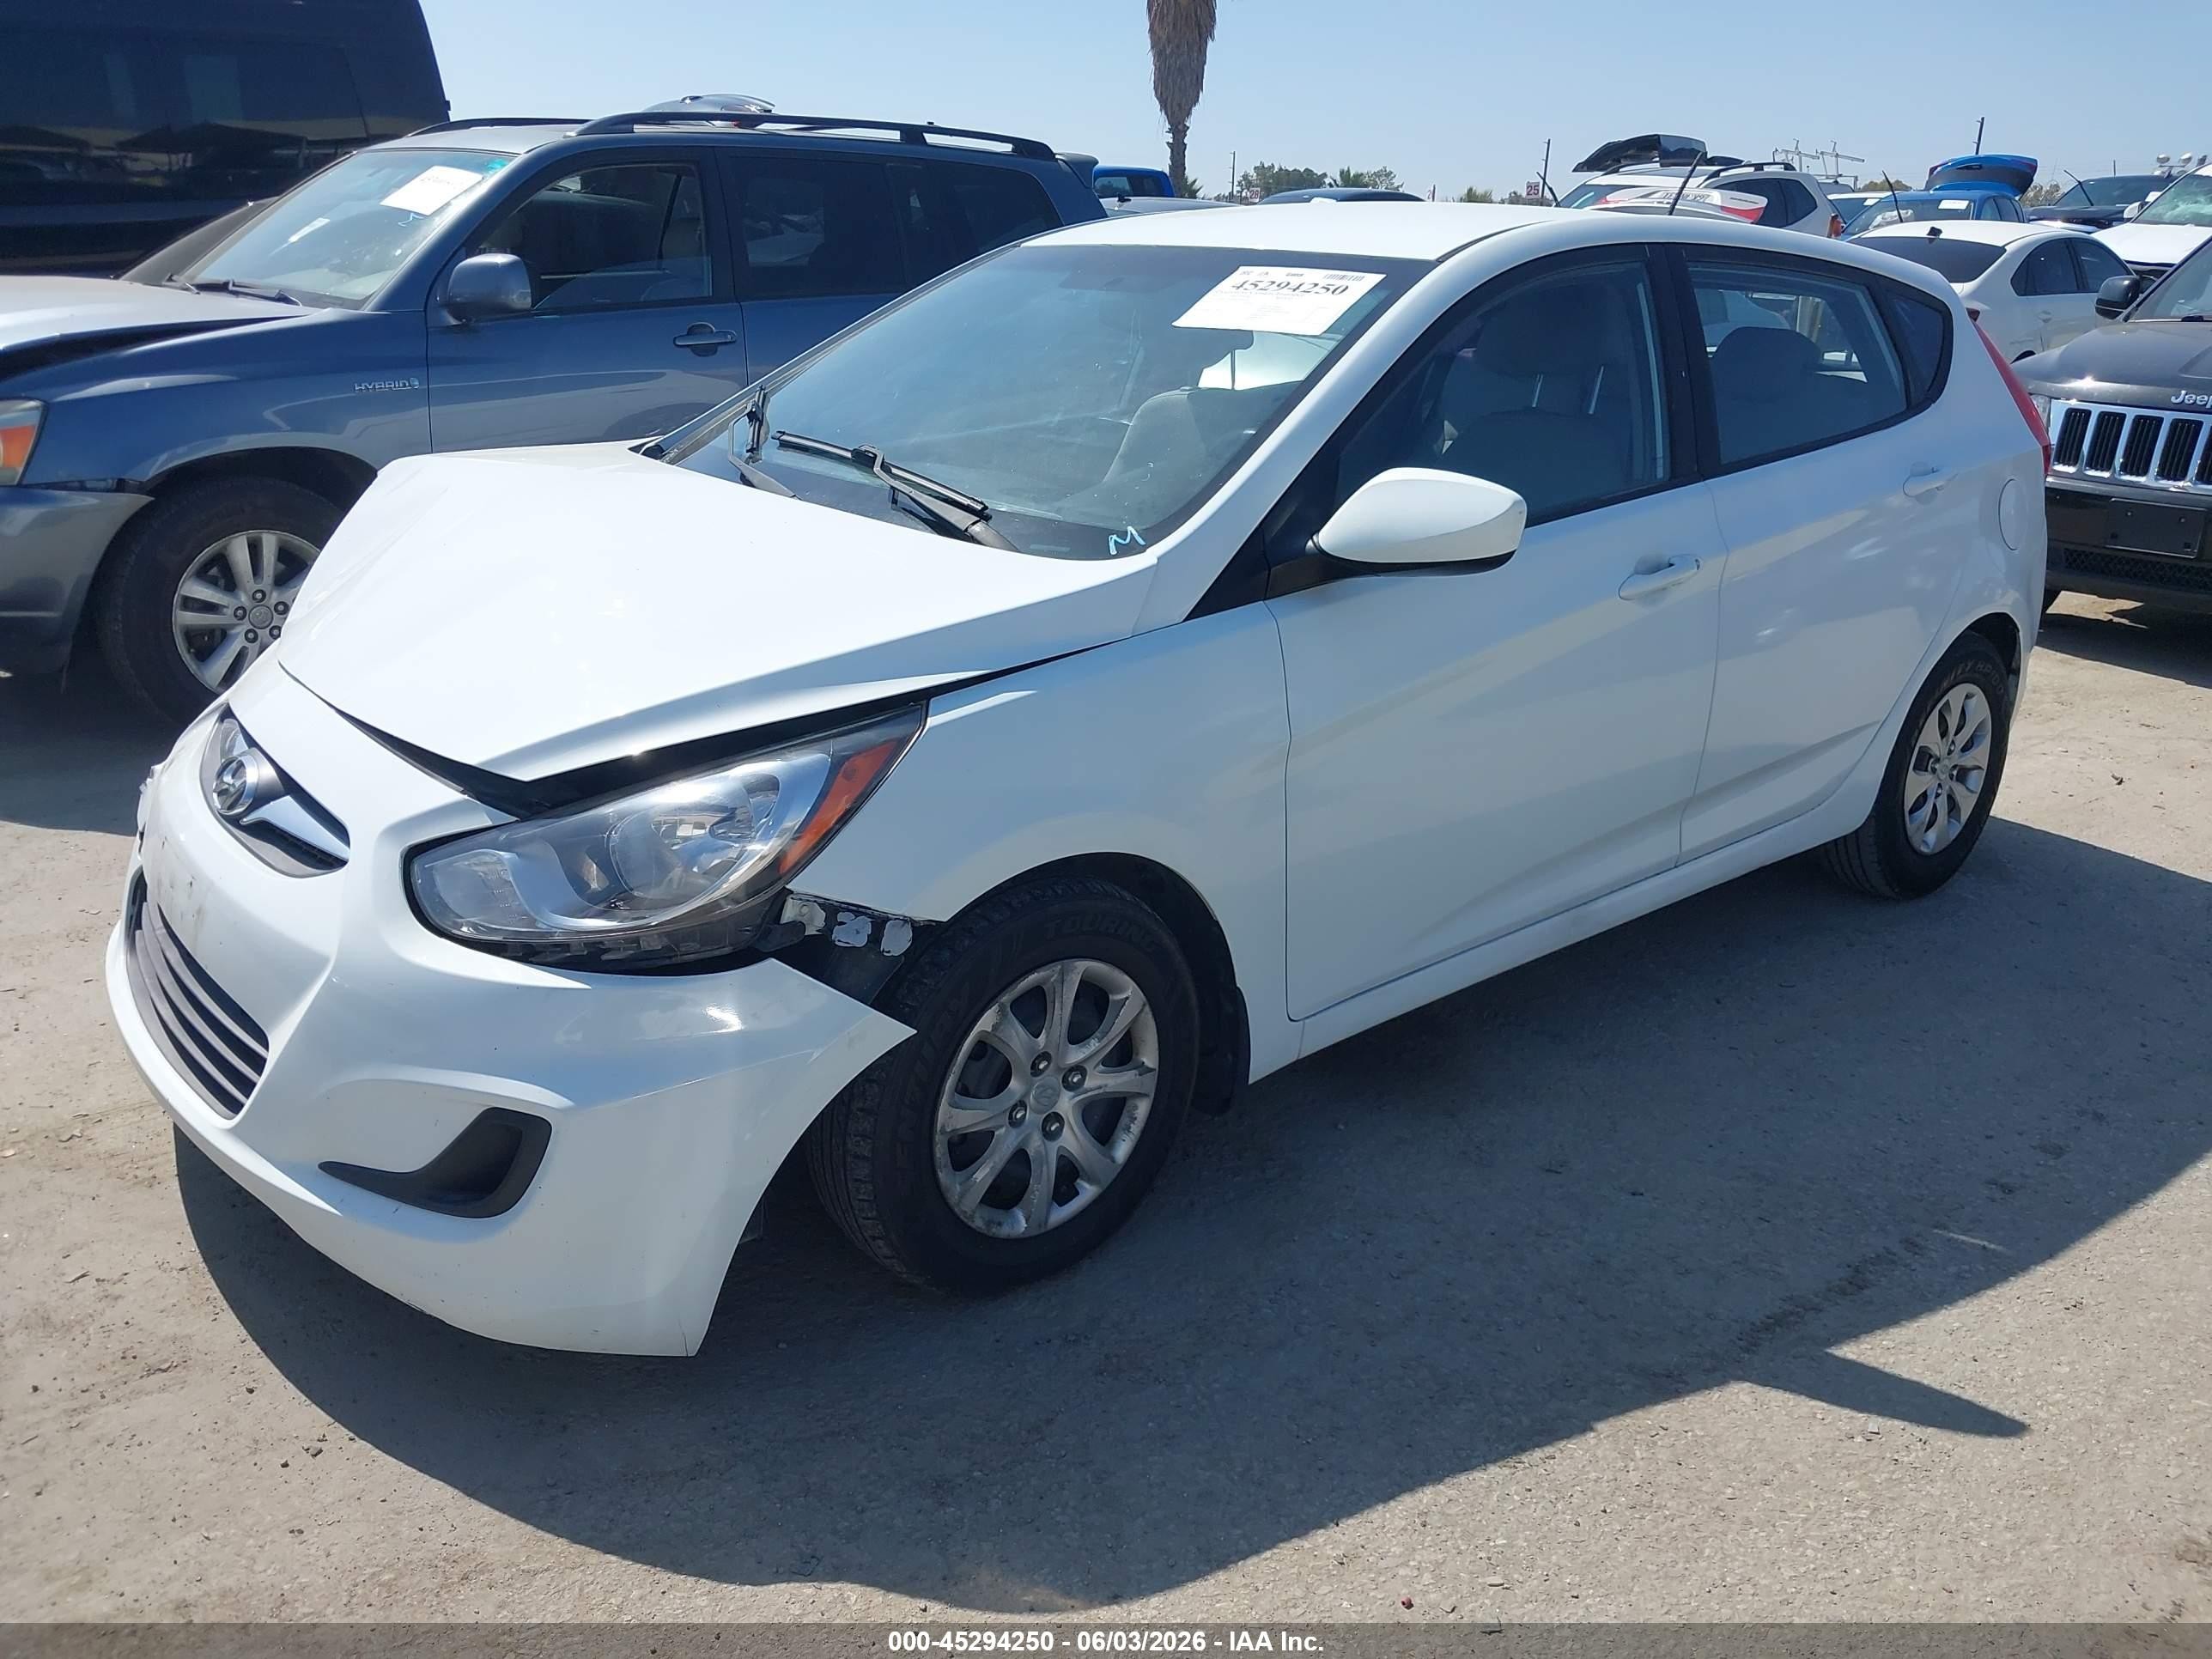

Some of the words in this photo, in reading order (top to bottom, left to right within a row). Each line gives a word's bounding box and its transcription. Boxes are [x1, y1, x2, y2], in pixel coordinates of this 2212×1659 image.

[1527, 185, 1540, 196] 25
[1231, 279, 1350, 296] 45294250
[354, 380, 410, 392] HYBRID
[1108, 526, 1146, 556] M
